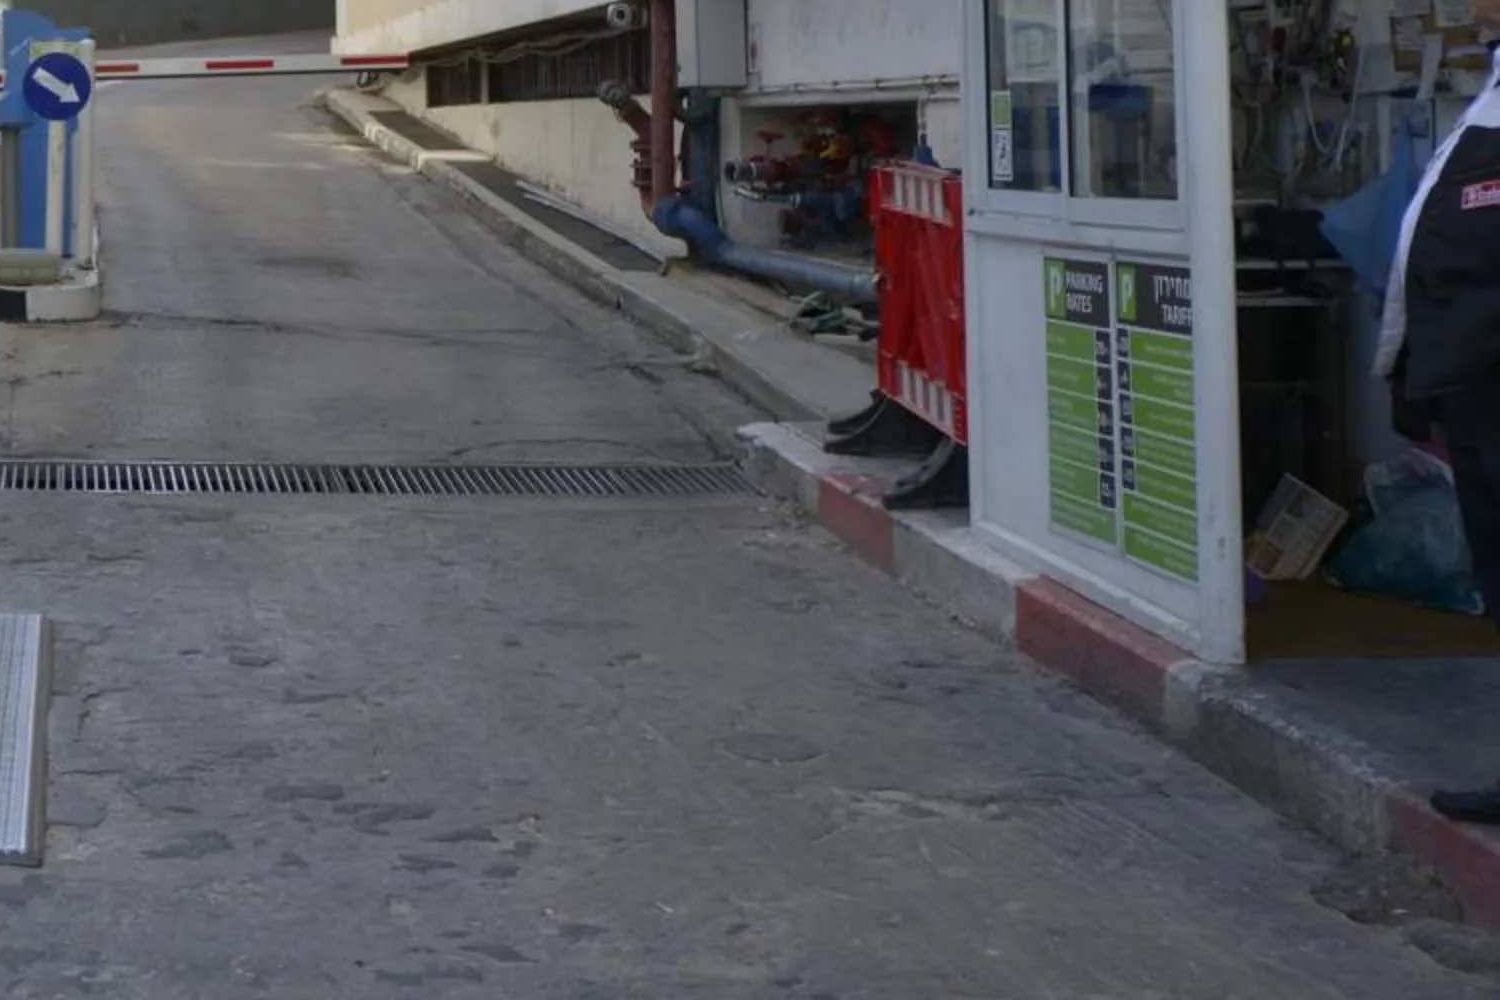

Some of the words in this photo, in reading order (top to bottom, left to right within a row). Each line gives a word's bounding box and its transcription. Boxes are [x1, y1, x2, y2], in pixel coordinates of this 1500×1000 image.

[1064, 271, 1103, 294] PARKING
[1121, 273, 1133, 313] P
[1065, 292, 1093, 313] RATES
